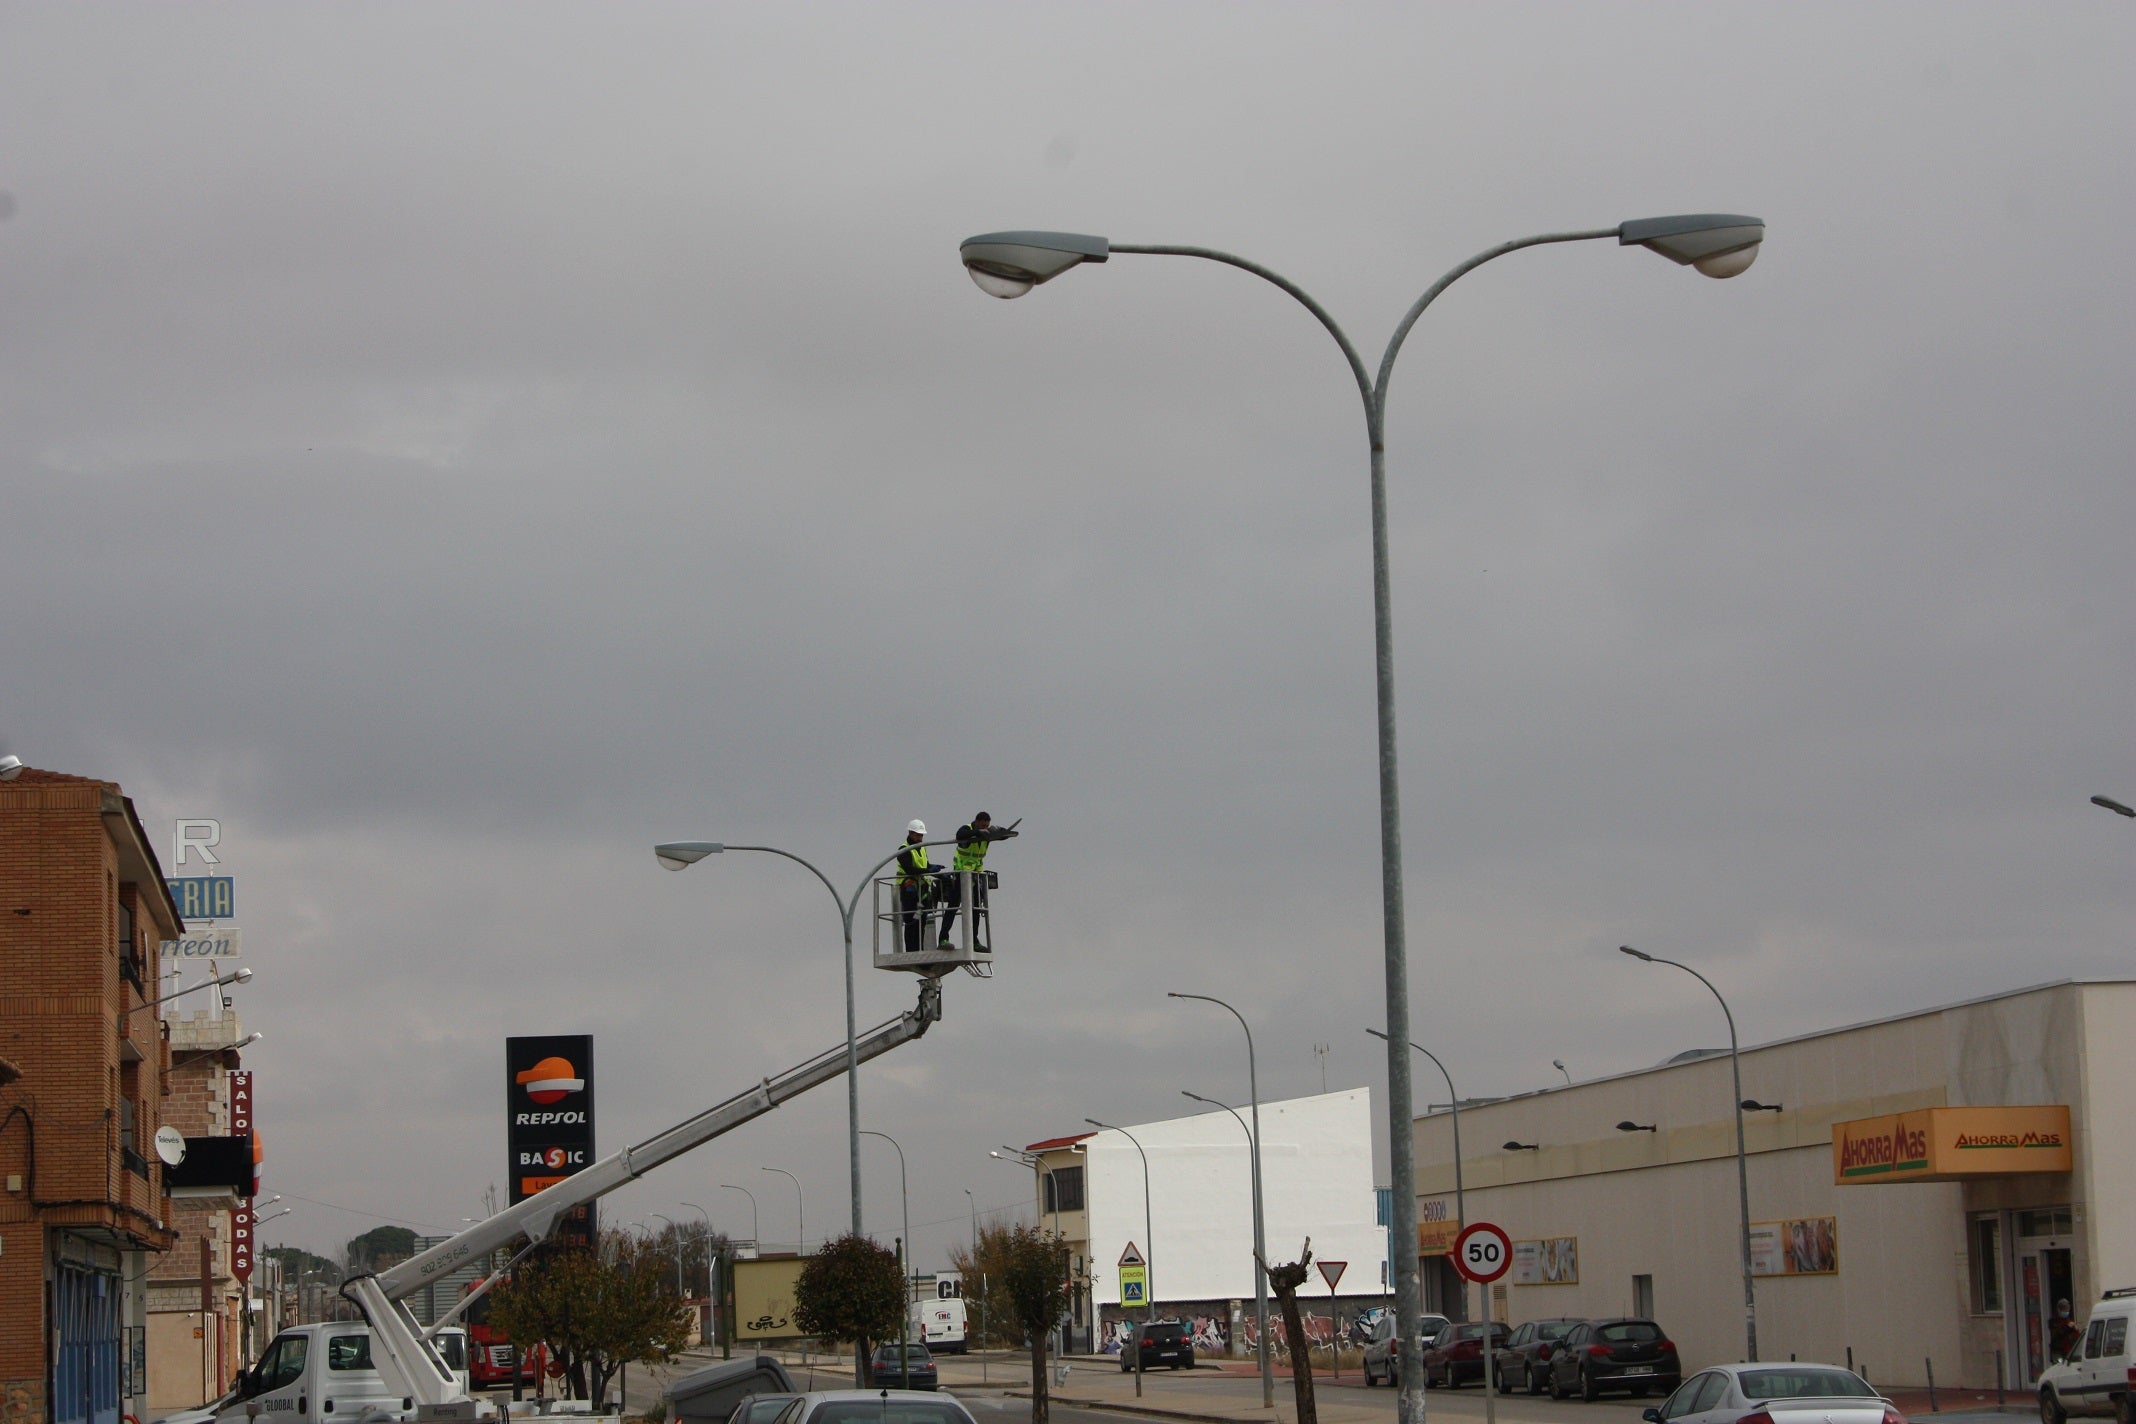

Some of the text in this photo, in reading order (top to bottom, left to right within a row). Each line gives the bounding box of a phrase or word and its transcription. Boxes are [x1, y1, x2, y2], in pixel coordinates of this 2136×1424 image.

[235, 1076, 248, 1136] SALO
[516, 1111, 587, 1125] REPSOL
[520, 1148, 584, 1168] BASIC
[535, 1180, 557, 1190] Lav
[1469, 1243, 1500, 1263] 50
